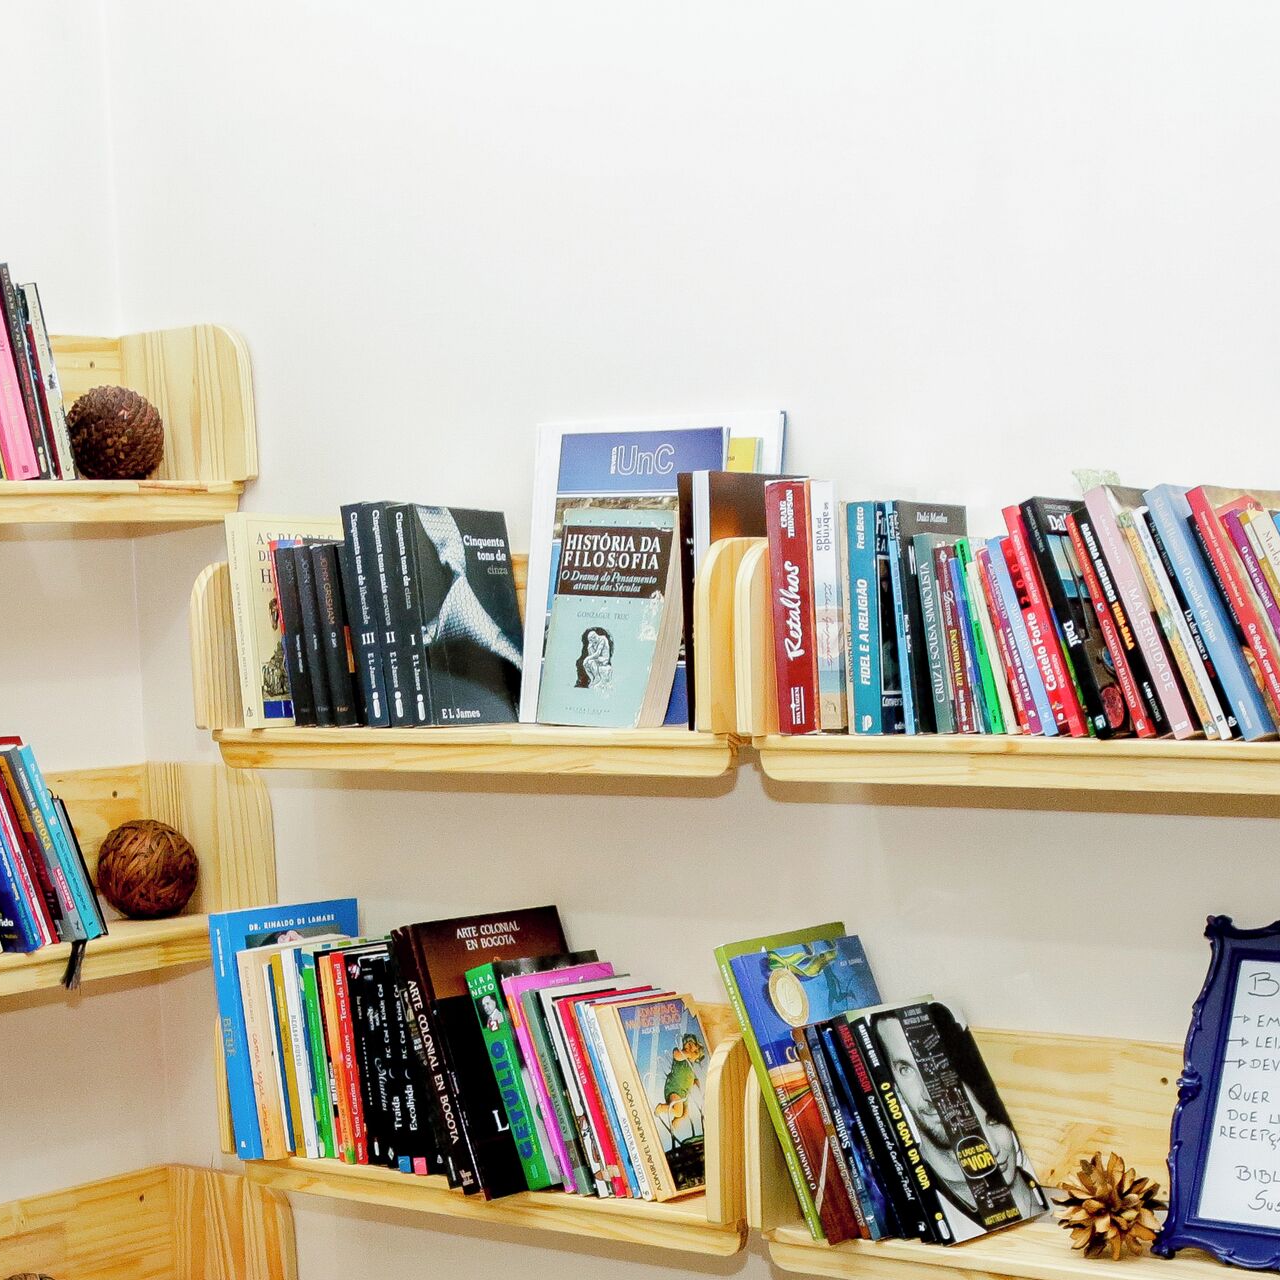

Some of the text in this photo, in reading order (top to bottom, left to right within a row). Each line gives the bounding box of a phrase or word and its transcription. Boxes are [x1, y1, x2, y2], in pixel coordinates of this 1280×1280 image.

[779, 500, 787, 527] CRAIG
[786, 489, 794, 537] THOMPSON
[821, 502, 831, 551] se abrindo
[463, 535, 504, 550] Cinquenta
[567, 532, 661, 552] HISTÓRIA DA
[815, 531, 824, 551] vida
[318, 554, 330, 581] JOHN
[477, 550, 507, 561] tons de
[564, 551, 659, 570] FILOSOFIA
[1077, 522, 1119, 602] MARTHA MEDEIROS
[487, 566, 508, 575] cinza
[562, 571, 657, 584] O Drama do Pensamento
[573, 581, 641, 593] através dos Séculos
[322, 582, 338, 625] GRISHAM
[777, 560, 807, 661] Retalhos
[855, 578, 871, 684] FIDEL E A RELIGIÃO
[919, 561, 945, 702] CRUZ E SOUSA SIMBOLISTA
[1061, 619, 1081, 646] Dalí
[1108, 600, 1137, 650] TREM-BALA
[1026, 611, 1058, 692] Castelo Forte
[1125, 587, 1176, 691] MATERNIDADE
[1099, 618, 1139, 708] CASAMENTO BLINDADO
[442, 709, 481, 718] E L James
[249, 914, 335, 931] DR. RINALDO DE LAMARE
[456, 921, 520, 939] ARTE COLONIAL
[466, 934, 516, 950] EN BOGOTA
[468, 974, 493, 989] LIRA
[471, 983, 495, 997] NETO
[837, 1023, 873, 1093] JAMES PATTERSON
[856, 1023, 880, 1067] MATTHEW QUICK
[407, 981, 460, 1144] ARTE COLONIAL EN BOGOTA
[621, 1080, 635, 1107] NOVO
[1228, 1083, 1269, 1103] QUER
[630, 1108, 647, 1143] MUNDO
[831, 1107, 852, 1149] Sublime
[1227, 1109, 1258, 1122] DOE
[879, 1081, 932, 1189] O LADO BOM DA VIDA
